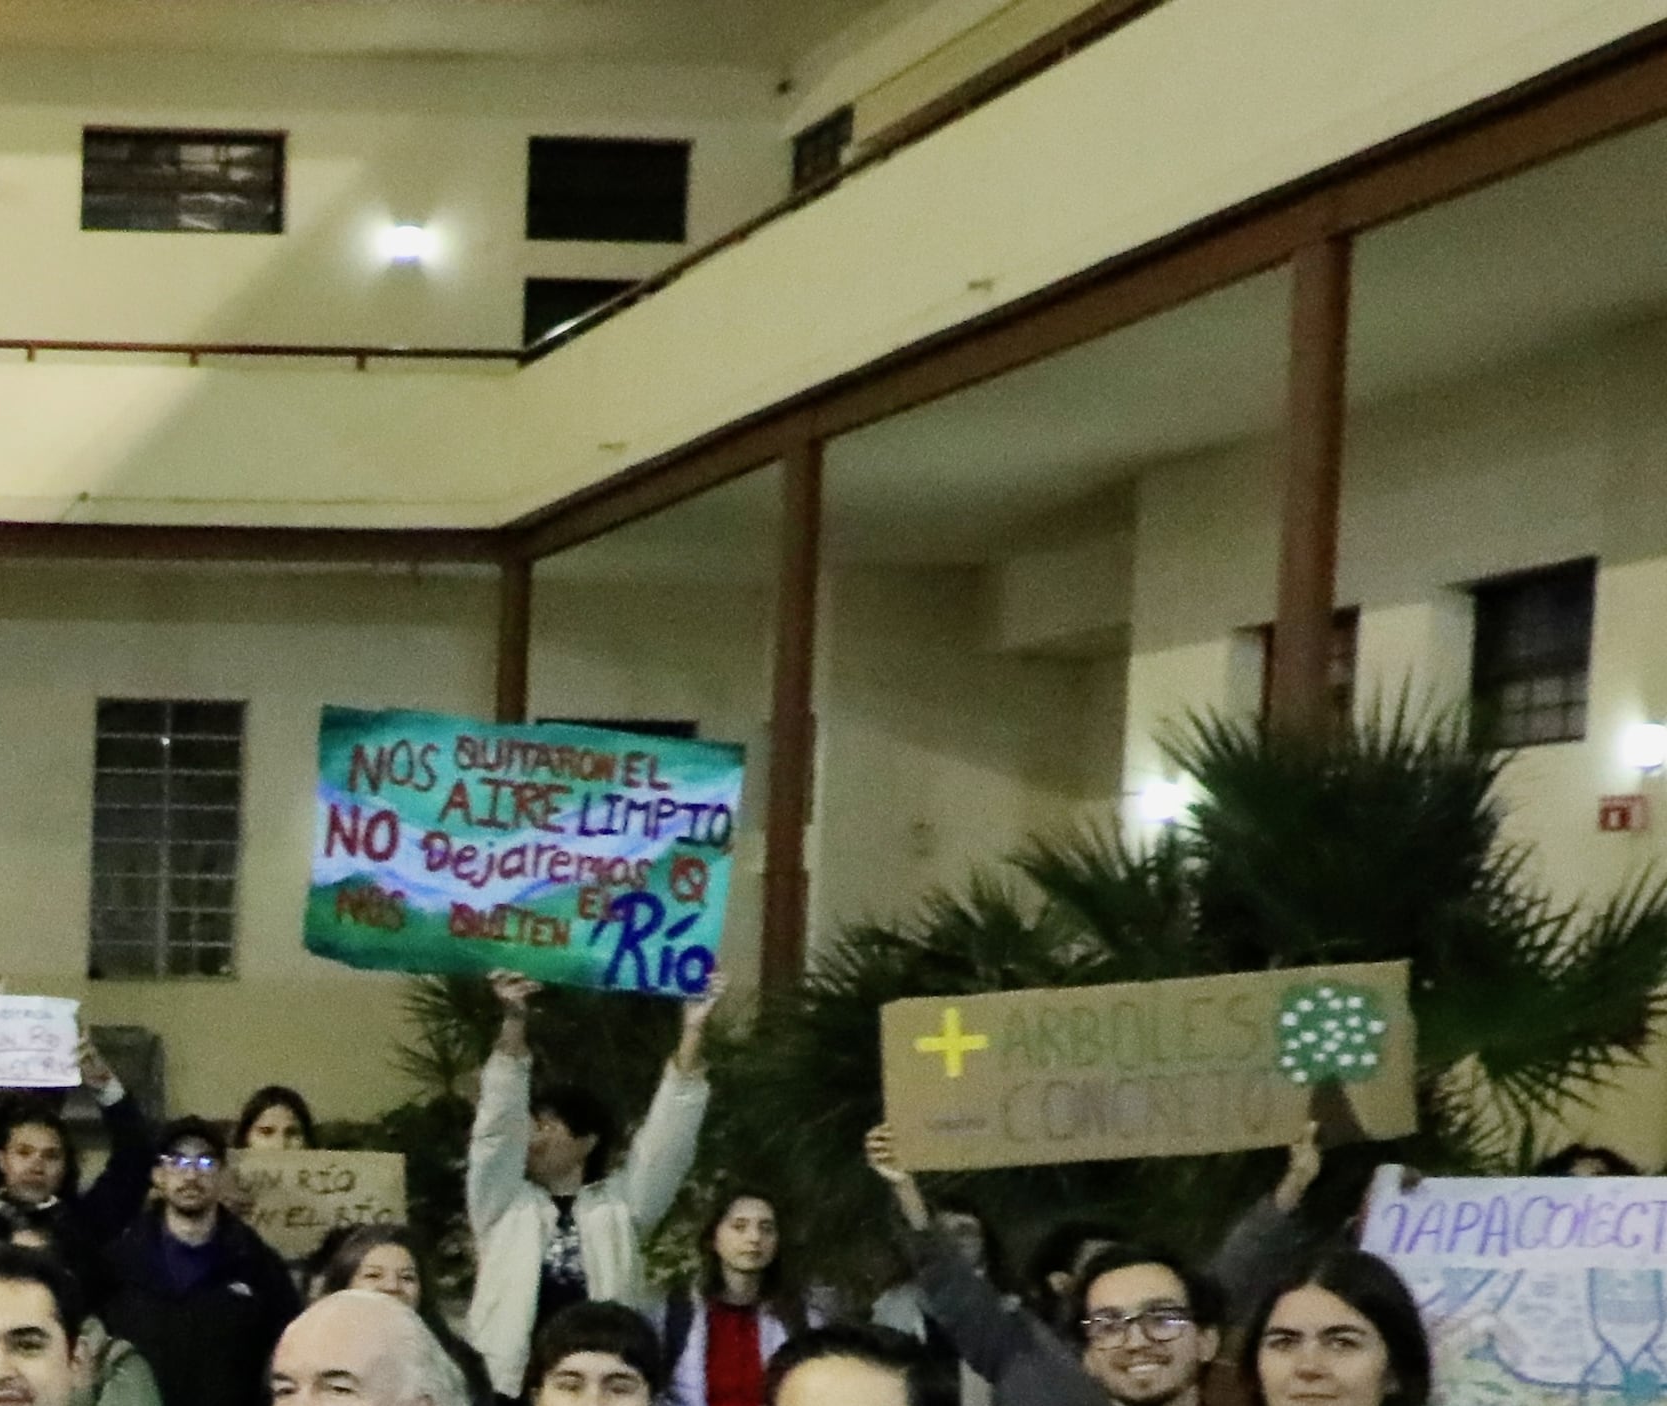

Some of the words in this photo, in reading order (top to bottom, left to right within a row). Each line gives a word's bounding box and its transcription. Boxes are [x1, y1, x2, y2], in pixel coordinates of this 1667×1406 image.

[347, 739, 438, 796] NOS
[455, 735, 615, 782] QUITARON
[622, 751, 672, 791] EL
[324, 802, 401, 863] NO
[439, 776, 572, 834] AIRE
[284, 1204, 327, 1229] EL
